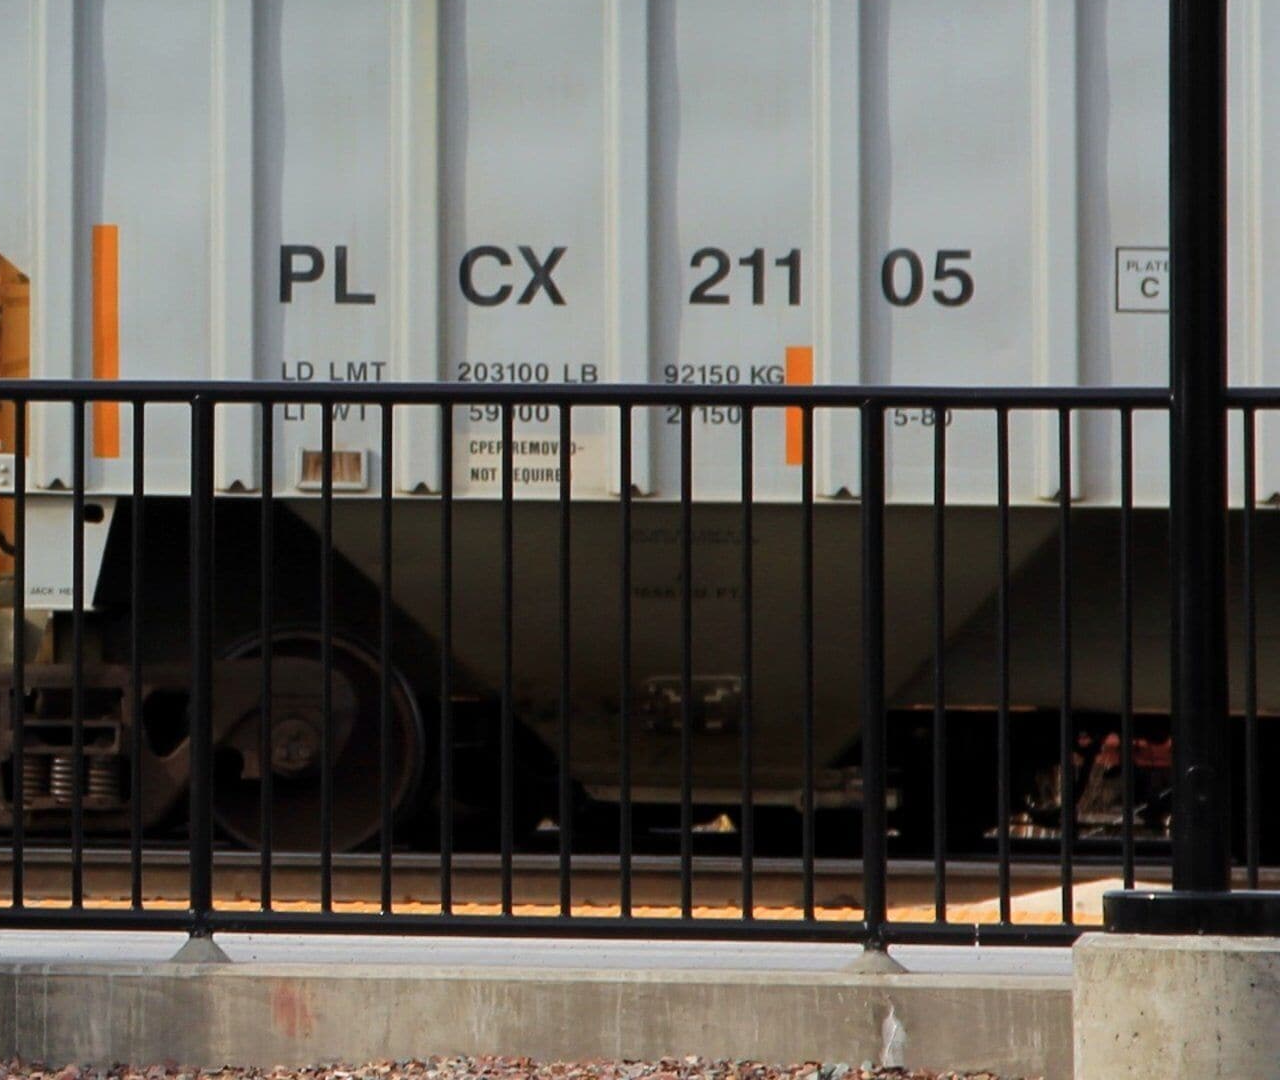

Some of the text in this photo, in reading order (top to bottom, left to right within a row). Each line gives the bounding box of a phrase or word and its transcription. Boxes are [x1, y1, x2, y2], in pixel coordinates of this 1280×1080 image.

[279, 244, 975, 309] PL CX 211 05
[1140, 276, 1160, 298] C
[282, 362, 785, 385] LD LMT 203100 LB 92150 KG
[469, 405, 550, 423] 5900
[666, 406, 742, 425] 2150
[470, 467, 497, 482] NOT
